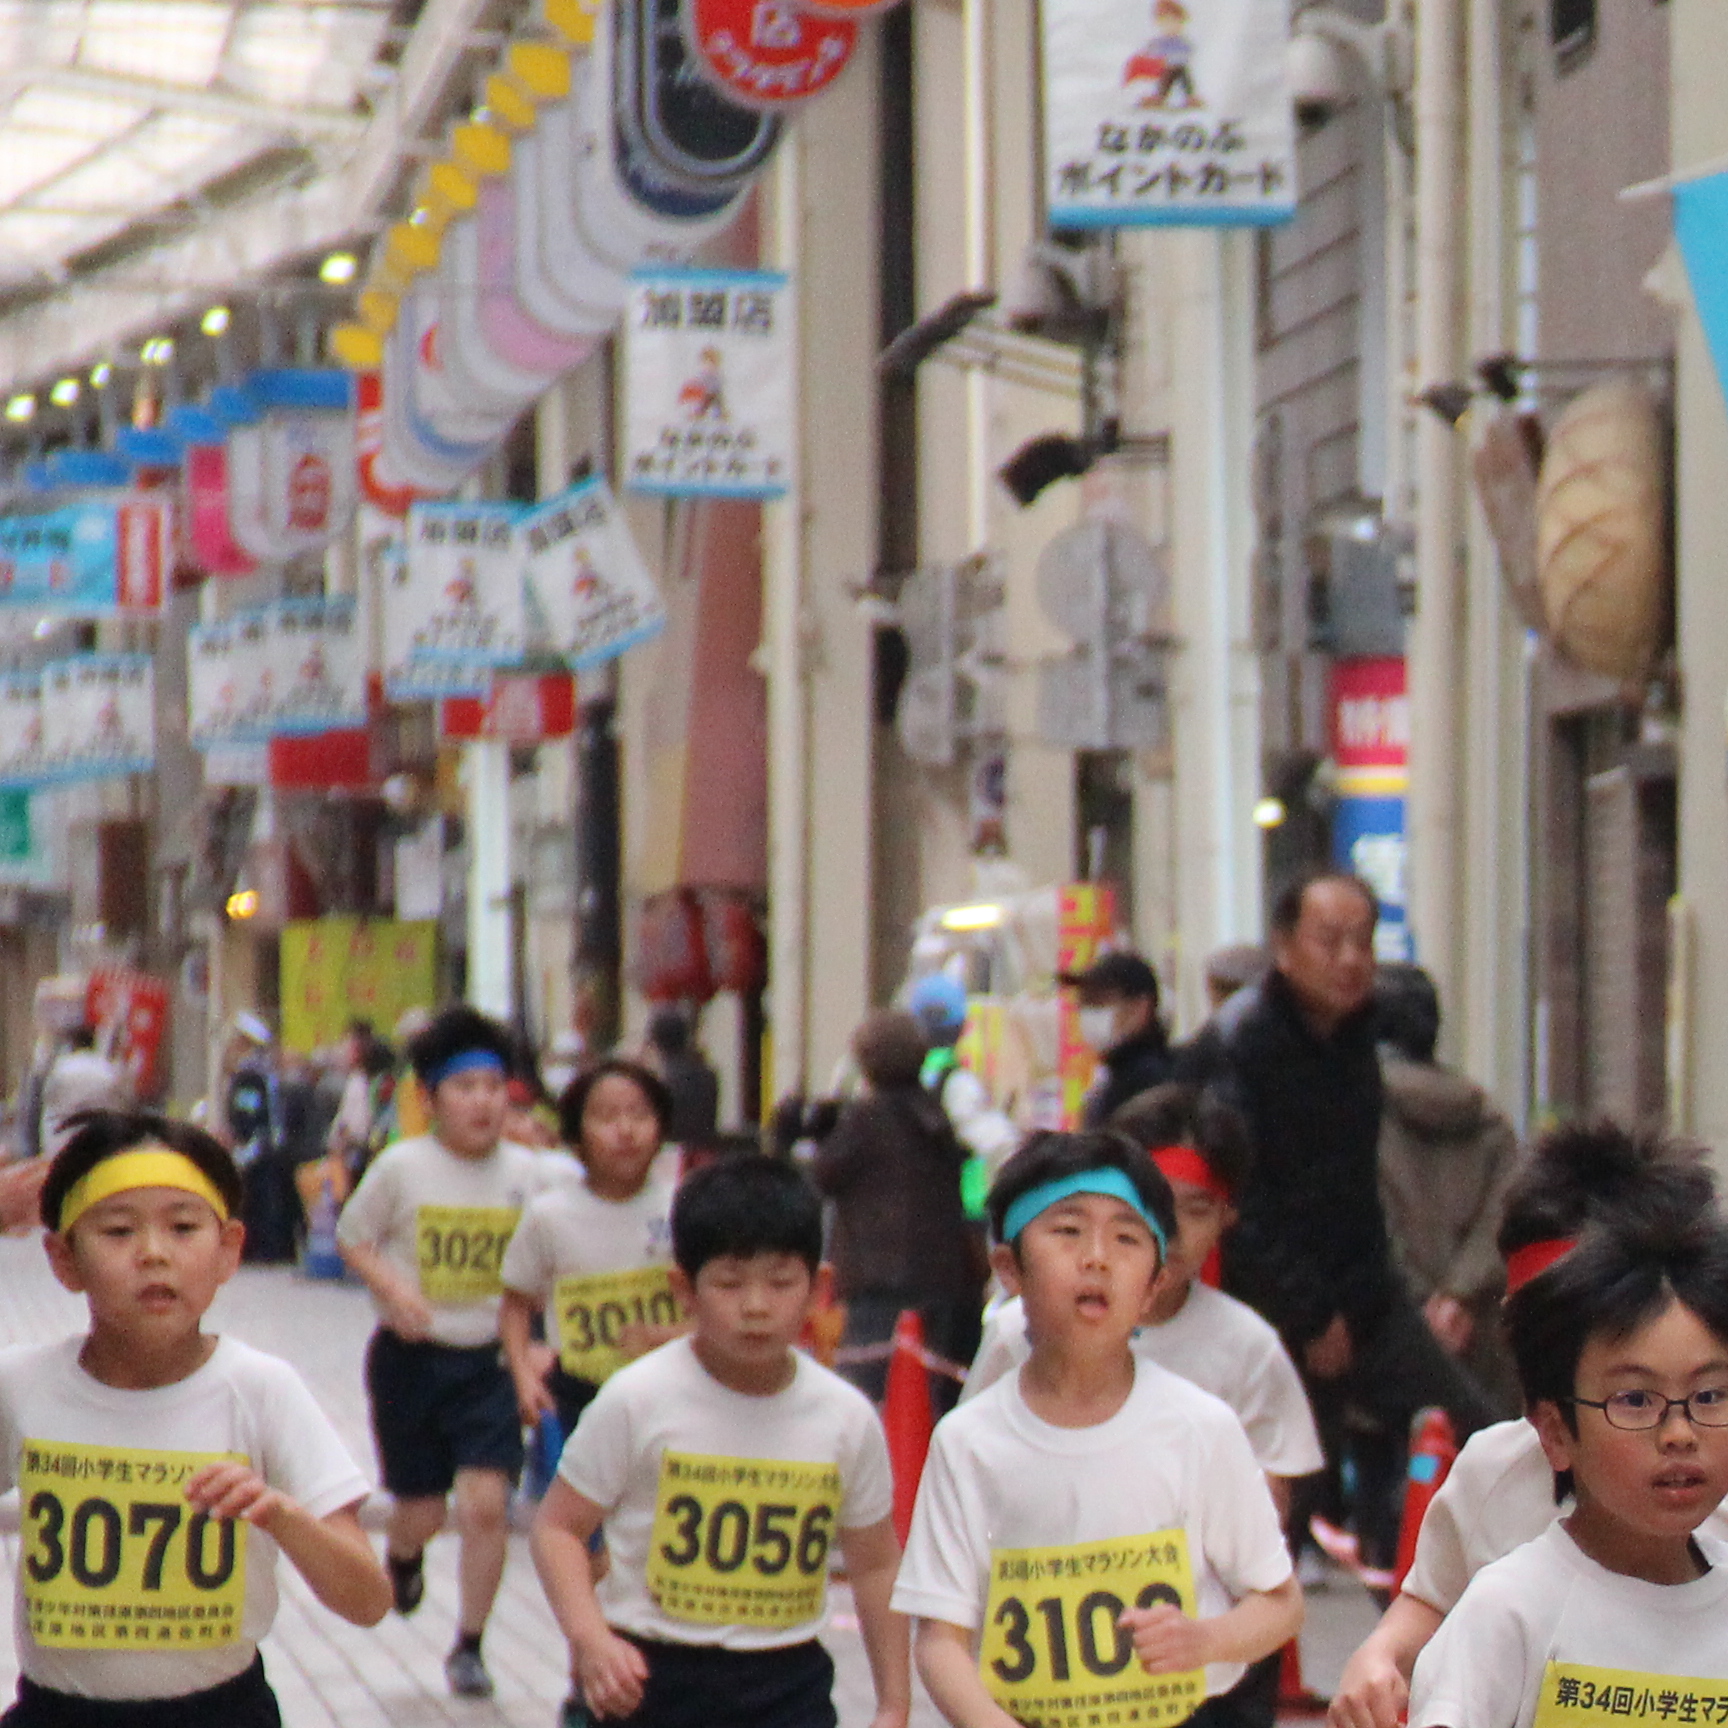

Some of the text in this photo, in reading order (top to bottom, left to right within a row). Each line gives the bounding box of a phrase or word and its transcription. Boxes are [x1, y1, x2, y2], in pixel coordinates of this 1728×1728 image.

[1097, 121, 1248, 153] なかのぶ
[1057, 162, 1284, 195] ポイントカード
[26, 1491, 235, 1592] 3070
[660, 1493, 833, 1576] 3056
